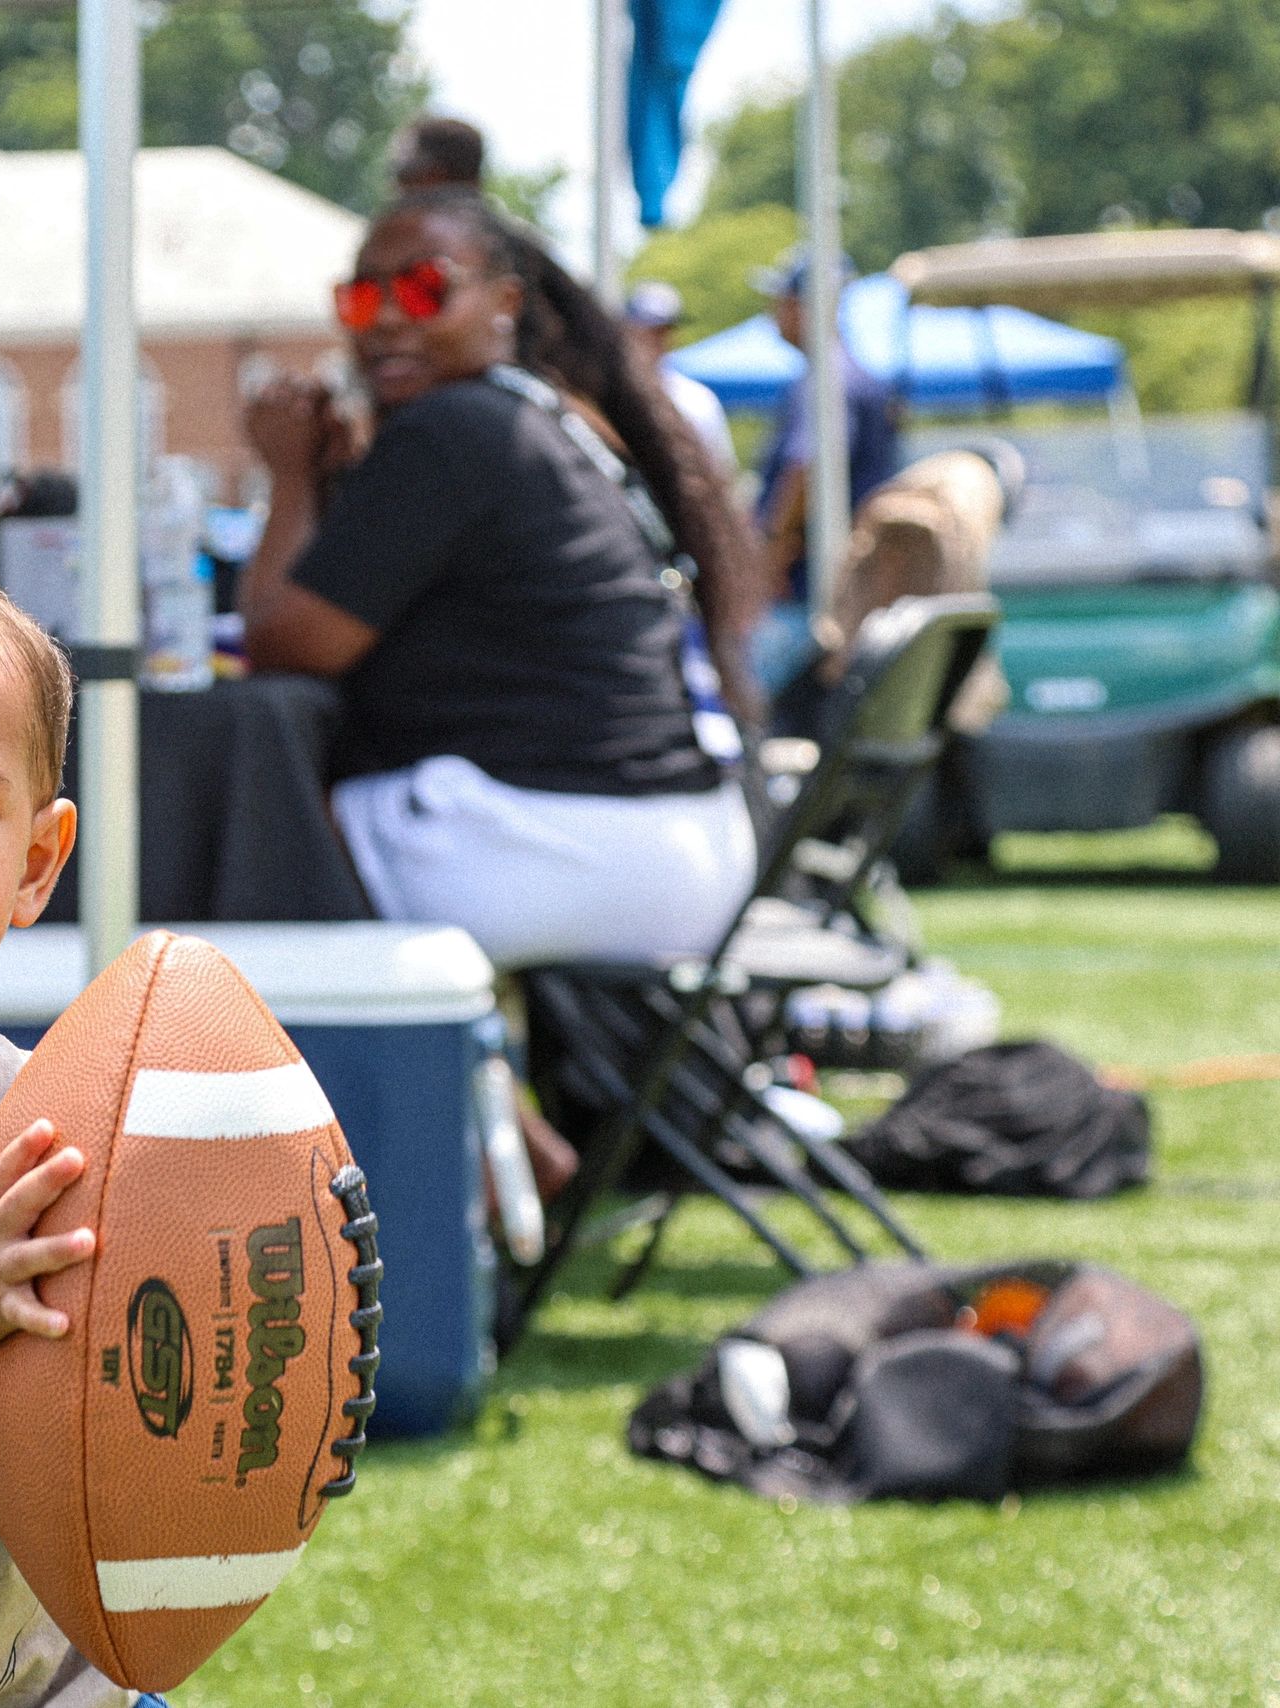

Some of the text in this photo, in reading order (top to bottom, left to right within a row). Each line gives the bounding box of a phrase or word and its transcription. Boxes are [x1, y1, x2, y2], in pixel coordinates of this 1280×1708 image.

[139, 1290, 185, 1438] GST
[215, 1327, 235, 1390] 1784
[238, 1216, 305, 1474] Wilson
